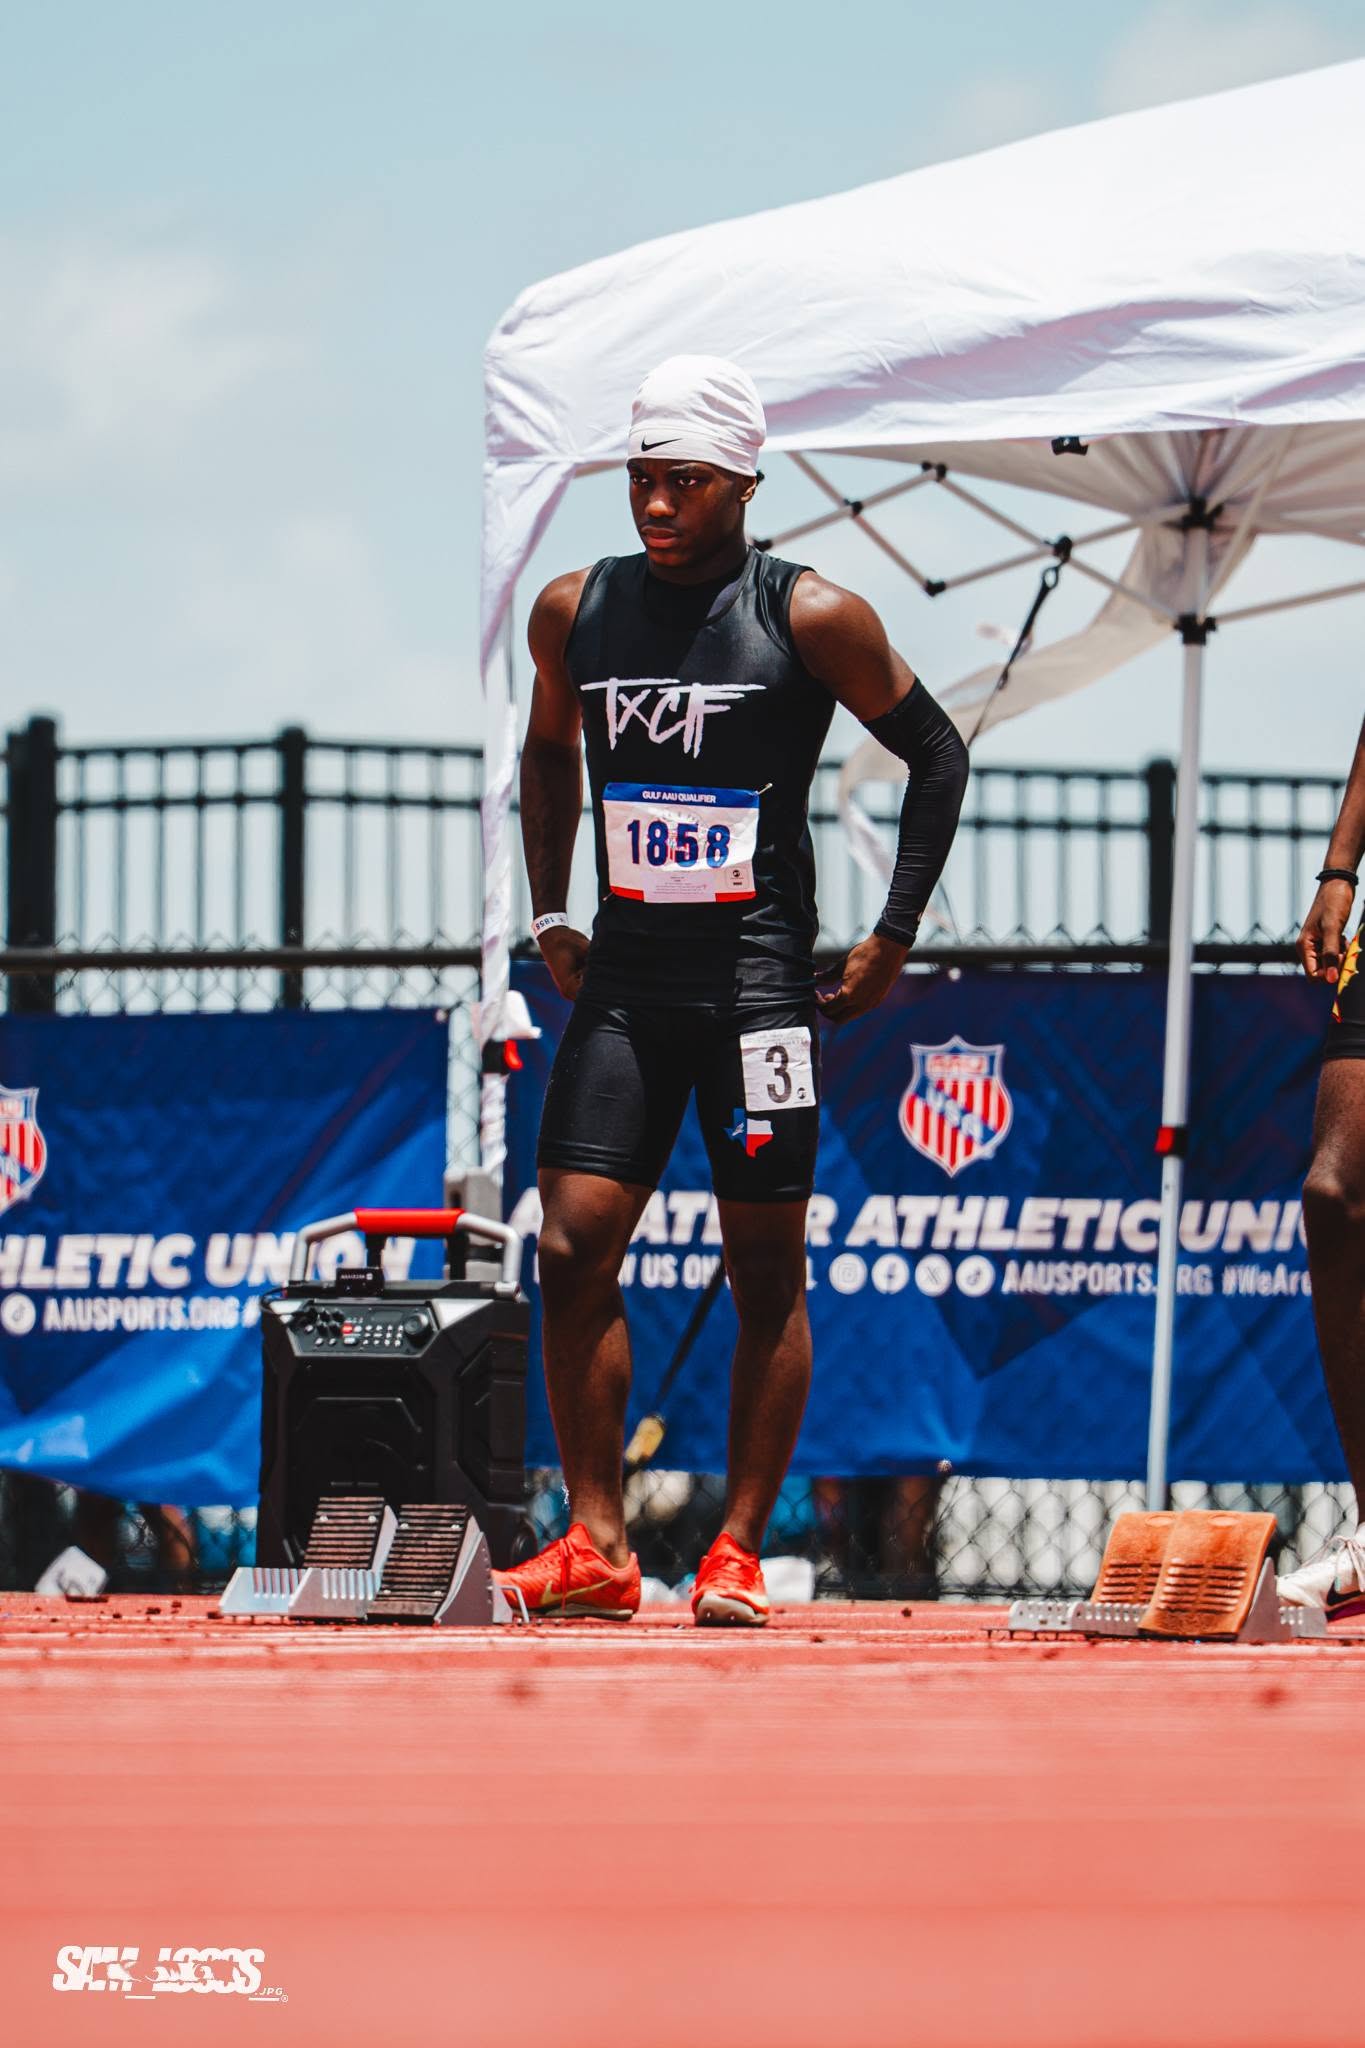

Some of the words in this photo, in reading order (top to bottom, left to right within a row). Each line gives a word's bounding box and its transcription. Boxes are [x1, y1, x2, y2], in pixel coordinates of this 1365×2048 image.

[642, 790, 661, 800] GULF
[662, 791, 677, 801] AAU
[678, 793, 716, 803] QUALIFIER
[627, 819, 731, 869] 1858
[765, 1045, 791, 1103] 3
[845, 1195, 1162, 1252] ATHLETIC
[1179, 1200, 1309, 1252] UNI
[641, 1253, 678, 1289] US
[1001, 1259, 1213, 1296] AAUSPORTS.RG
[43, 1295, 239, 1331] AAUSPORTS.ORG
